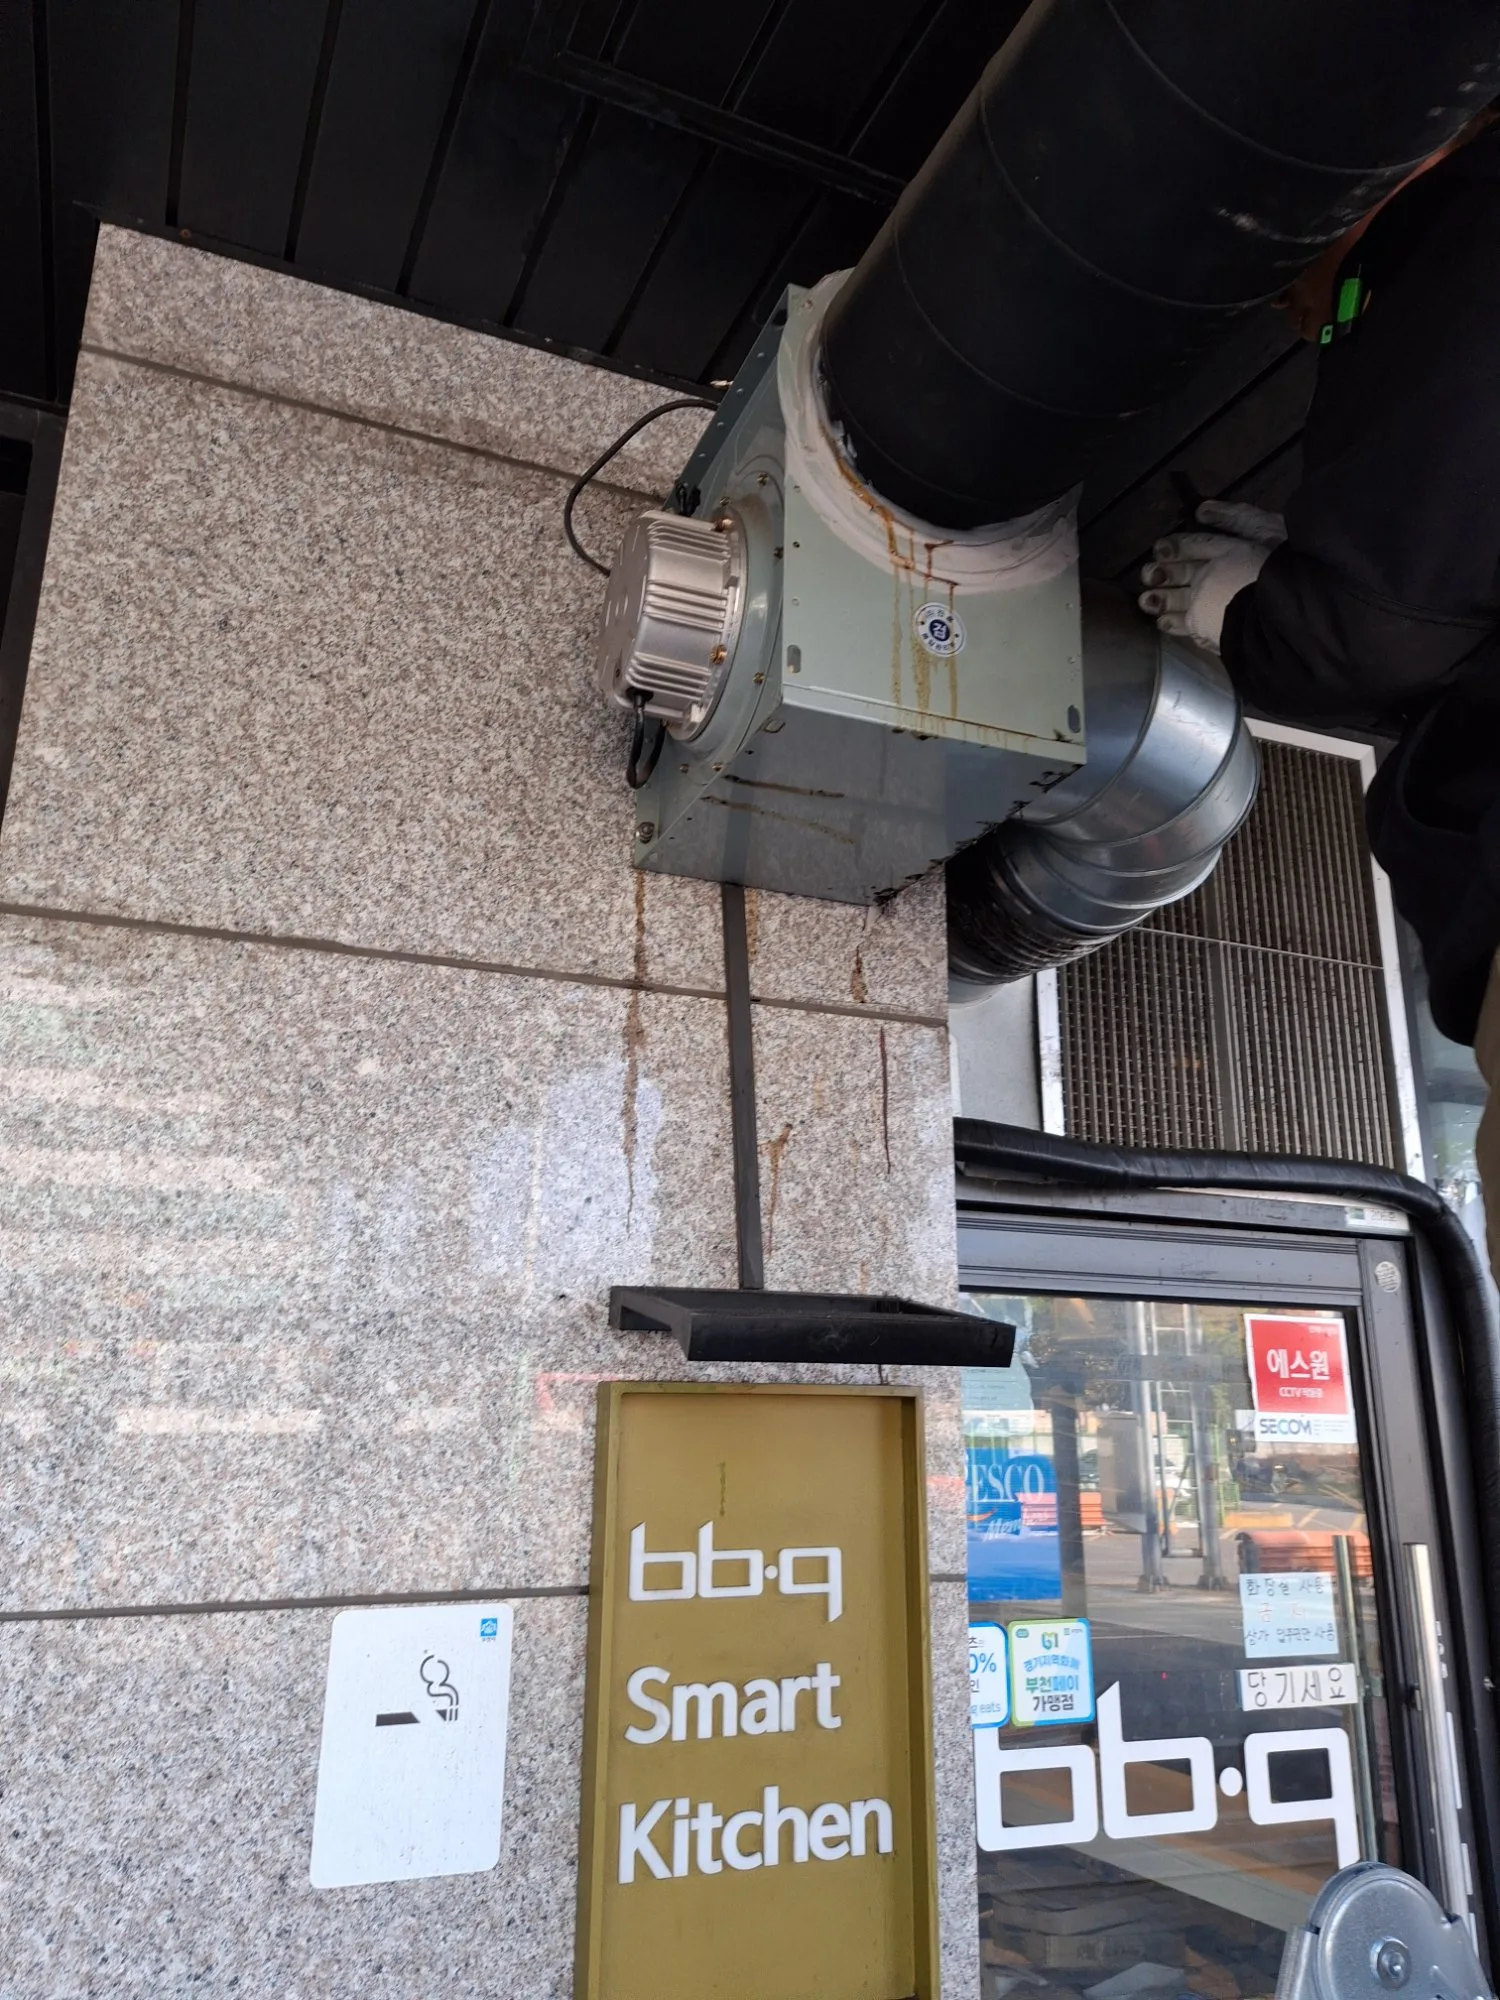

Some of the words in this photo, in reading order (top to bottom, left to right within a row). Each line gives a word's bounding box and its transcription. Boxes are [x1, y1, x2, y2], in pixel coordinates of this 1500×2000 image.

[1267, 1348, 1330, 1380] 에스원
[1260, 1418, 1312, 1435] SECOM
[964, 1456, 1045, 1503] ESCO
[1025, 1675, 1079, 1694] 부천페이
[1247, 1667, 1346, 1707] 당기세요
[624, 1662, 841, 1745] Smart
[1032, 1694, 1074, 1712] 가맹점
[617, 1785, 893, 1884] Kitchen
